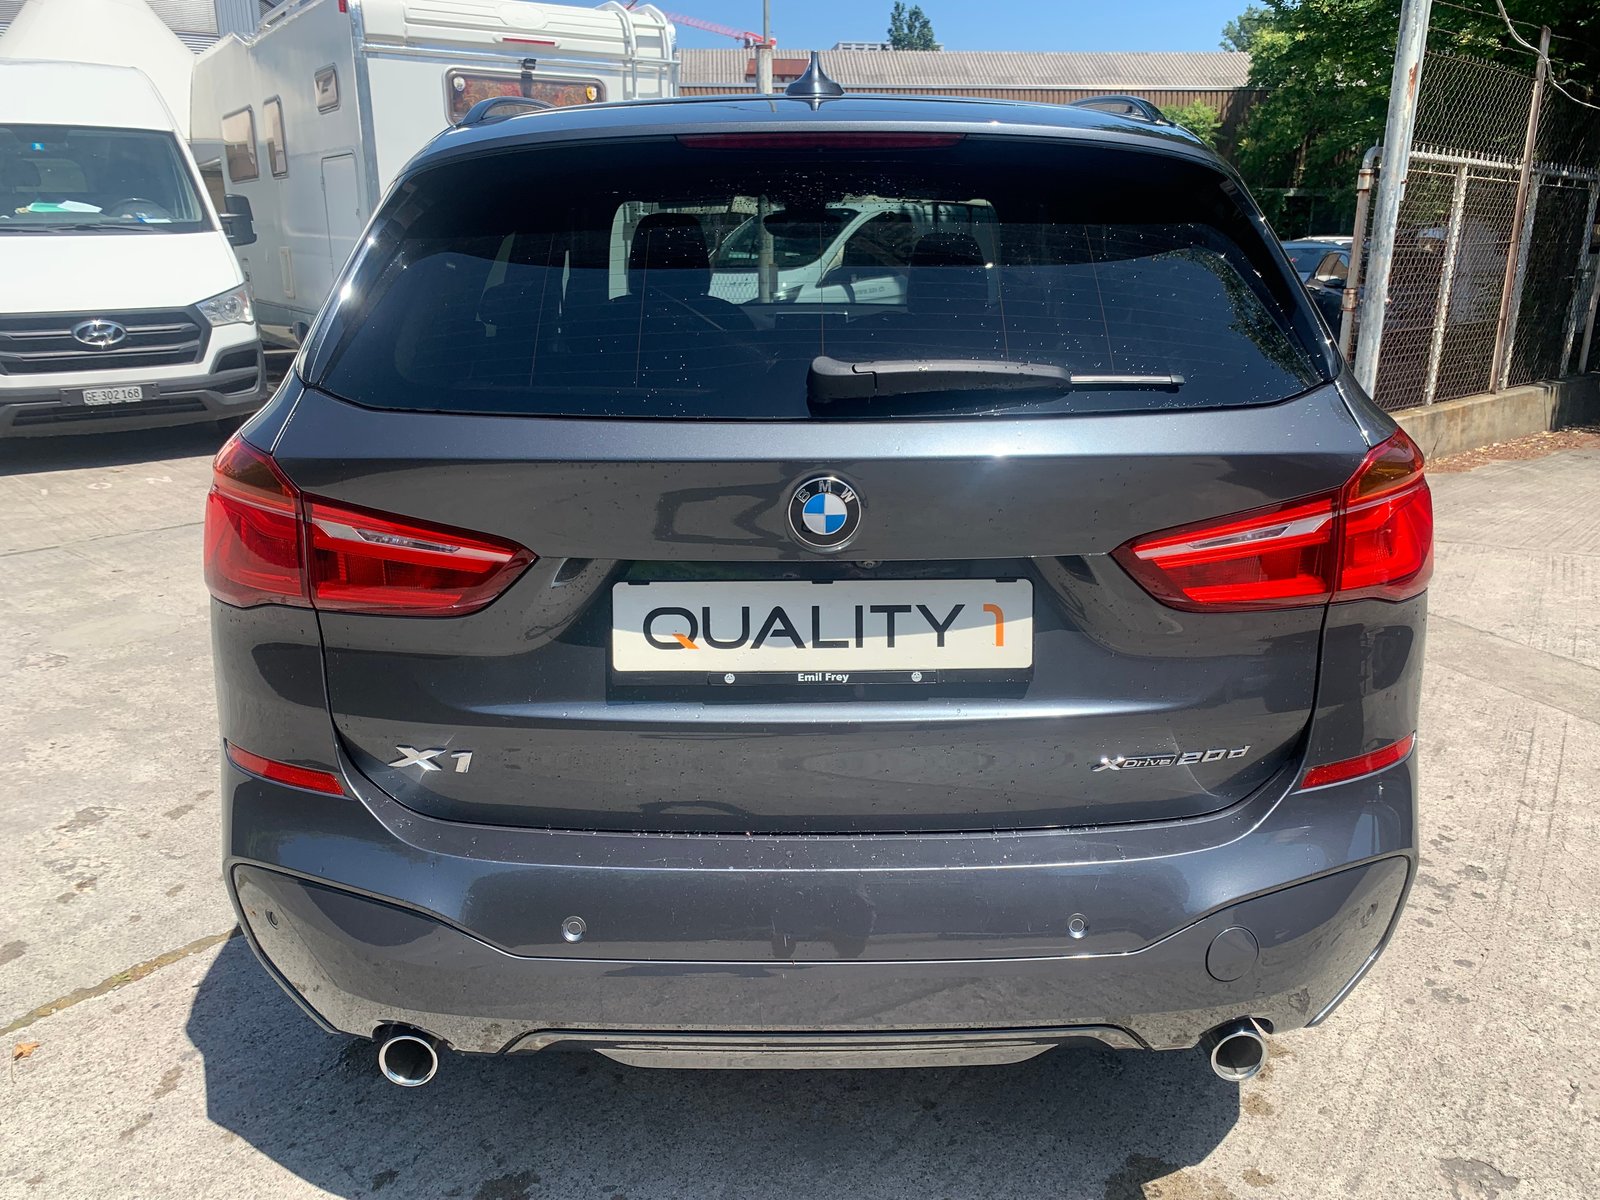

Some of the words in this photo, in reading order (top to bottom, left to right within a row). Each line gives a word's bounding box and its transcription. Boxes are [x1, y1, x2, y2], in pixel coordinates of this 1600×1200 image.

[796, 479, 856, 504] BMW
[642, 603, 966, 650] QUALITY
[983, 603, 1005, 647] 1
[797, 672, 823, 683] Emil
[825, 672, 850, 684] Frey
[387, 744, 473, 774] X1
